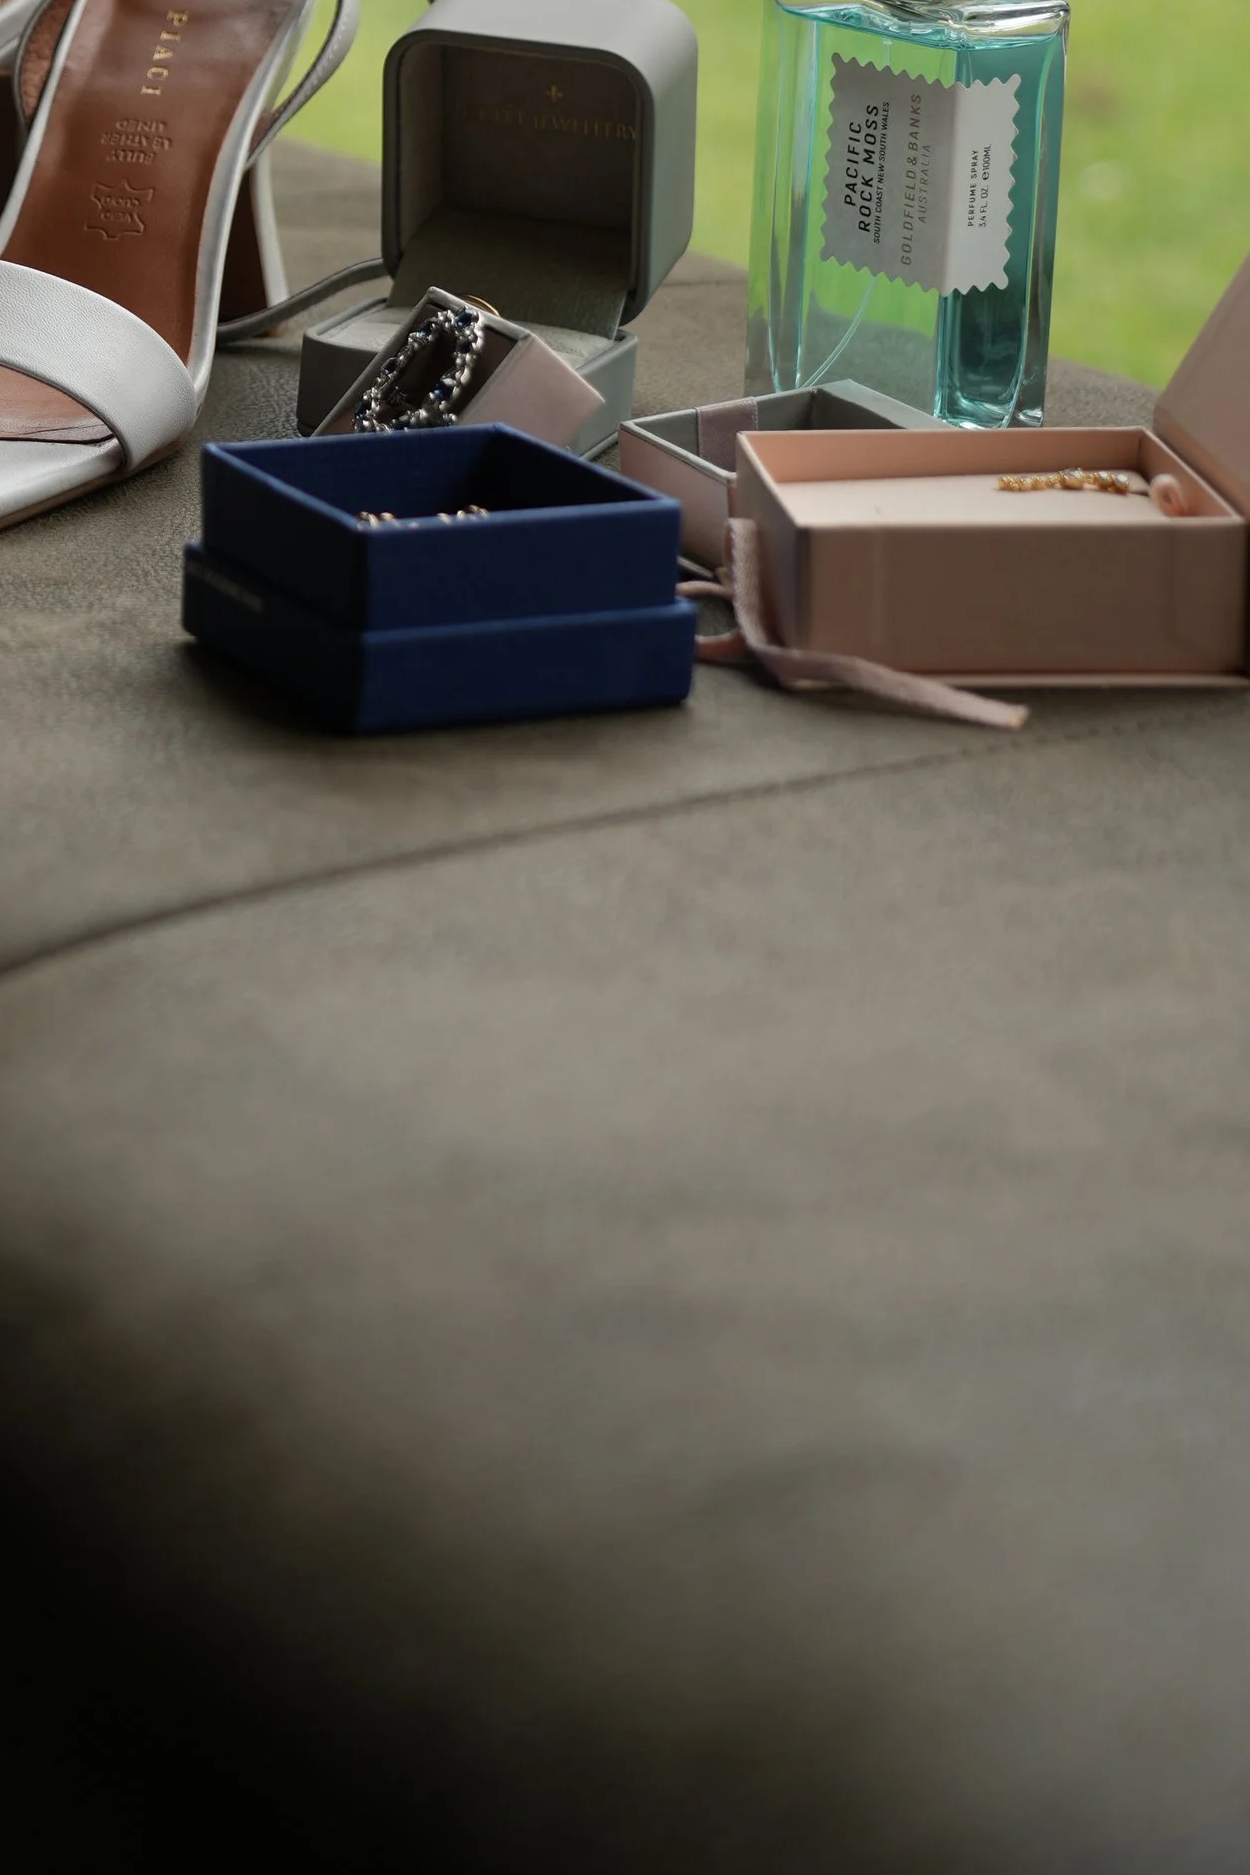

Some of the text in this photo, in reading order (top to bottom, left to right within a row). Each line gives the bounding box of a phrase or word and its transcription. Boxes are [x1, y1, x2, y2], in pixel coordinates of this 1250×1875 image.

[140, 8, 190, 96] PIACI
[844, 121, 862, 207] PACIFIC
[858, 104, 879, 232] ROCK MOSS
[873, 101, 890, 244] SOUTH COAST NEW SOUTH WALES
[900, 93, 922, 266] GOLDFIELD & BANKS
[917, 145, 932, 224] AUSTRALIA
[967, 150, 979, 227] PERFUME SPRAY
